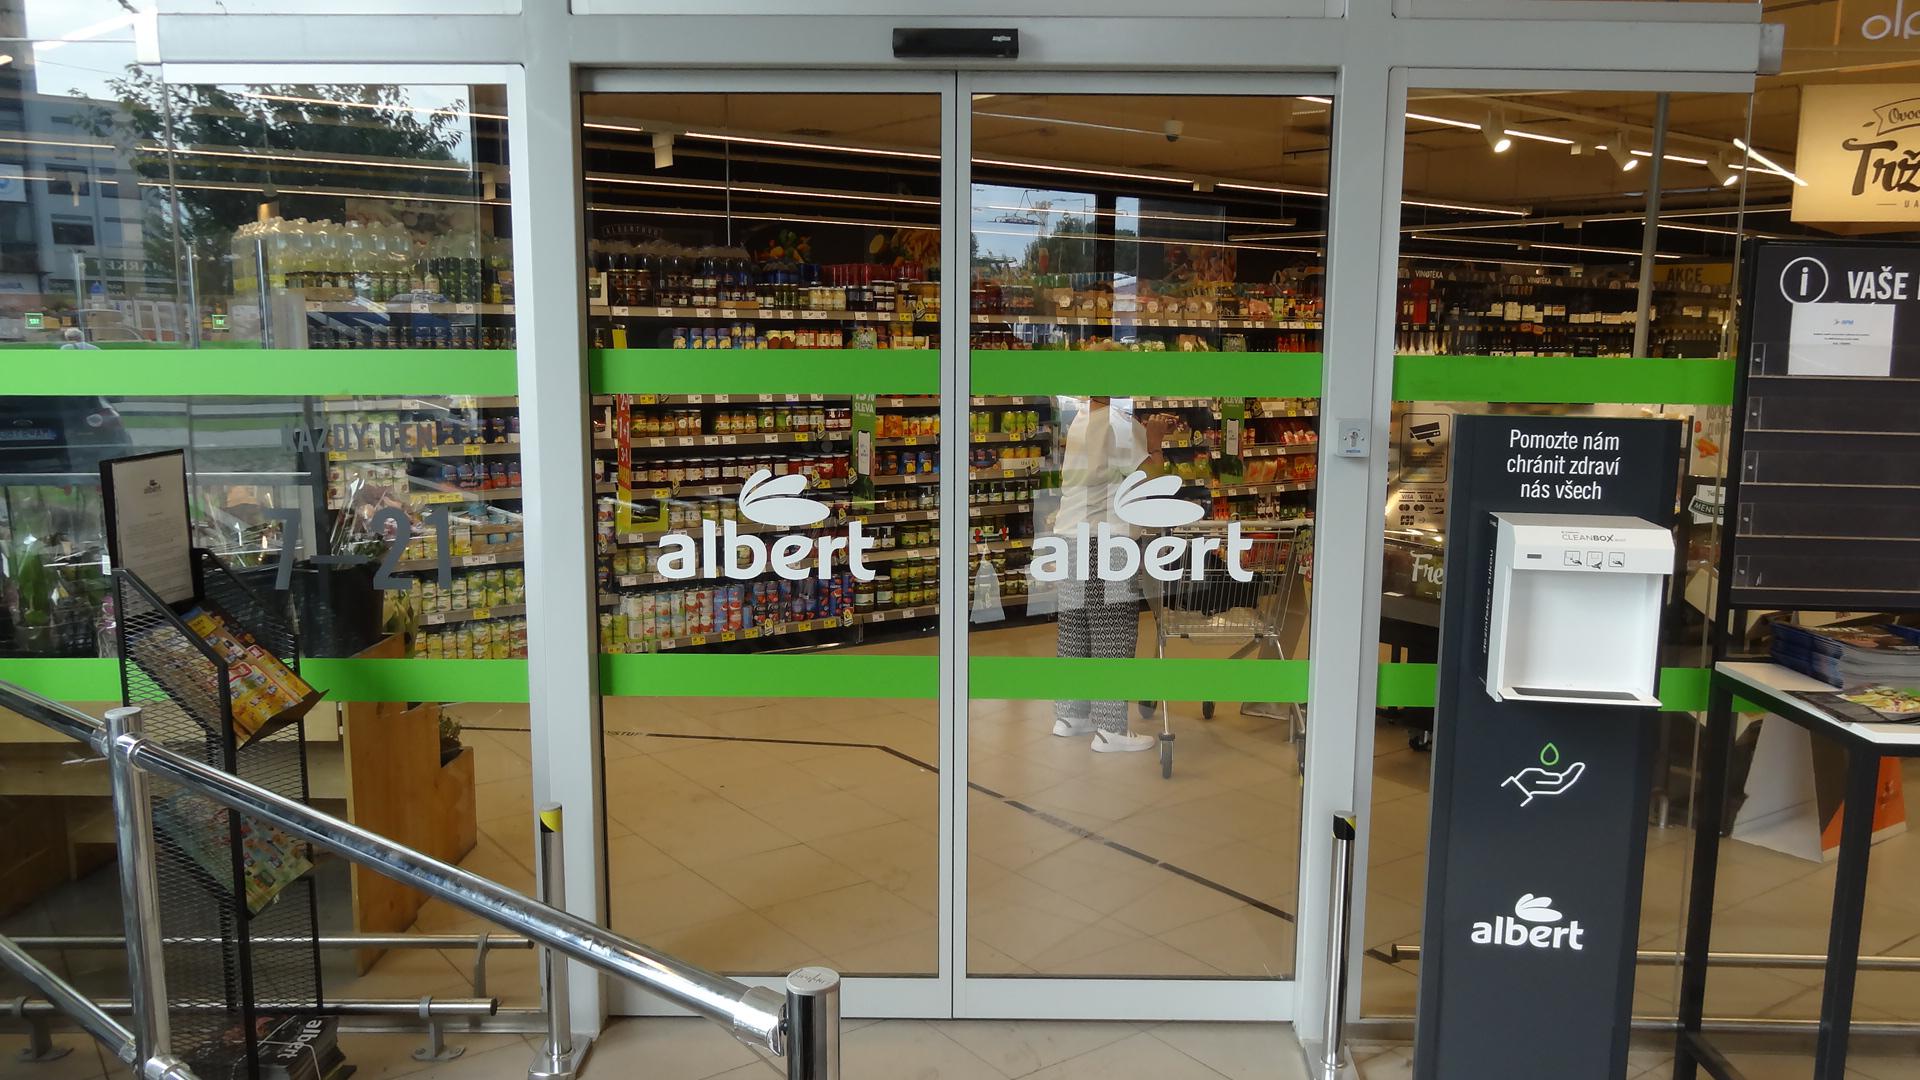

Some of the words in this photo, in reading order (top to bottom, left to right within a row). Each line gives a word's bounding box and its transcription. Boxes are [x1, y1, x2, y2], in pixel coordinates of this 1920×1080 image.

[1666, 267, 1704, 284] AKCE
[1847, 265, 1909, 300] VAŠE
[379, 421, 433, 452] DEN
[1509, 429, 1578, 450] Pomozte
[1583, 431, 1620, 451] nám
[1506, 453, 1565, 474] chránit
[1568, 456, 1621, 476] zdraví
[1520, 479, 1550, 499] nás
[1555, 480, 1602, 500] všech
[657, 518, 876, 581] albert
[1029, 521, 1254, 583] albert
[1561, 533, 1614, 543] CLEANBOX
[1471, 916, 1584, 951] albert
[277, 1019, 323, 1059] albert
